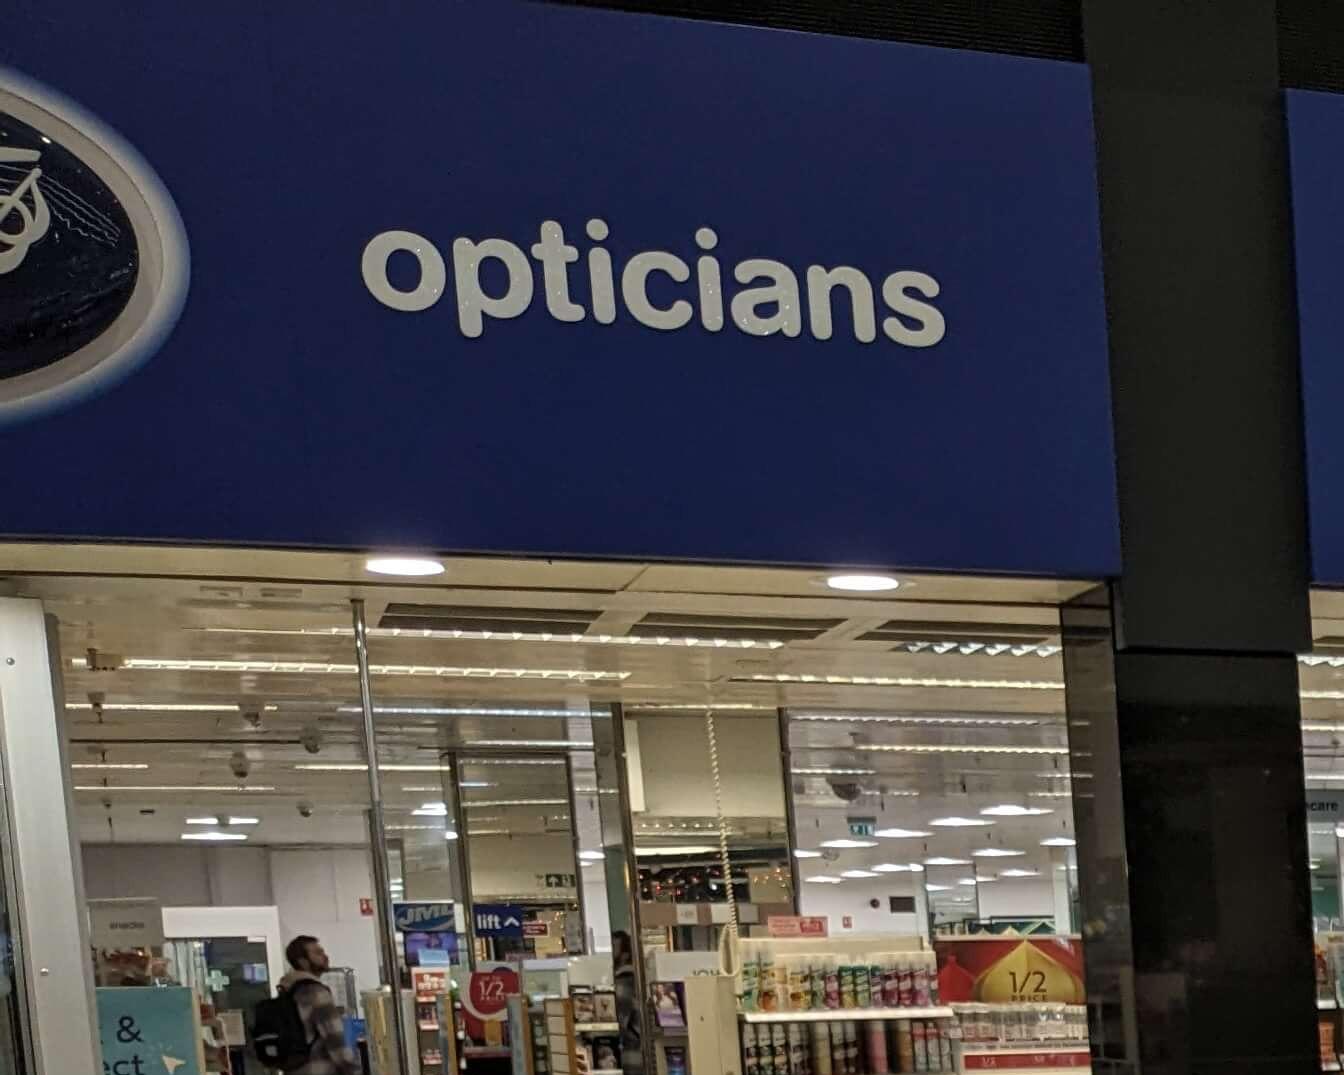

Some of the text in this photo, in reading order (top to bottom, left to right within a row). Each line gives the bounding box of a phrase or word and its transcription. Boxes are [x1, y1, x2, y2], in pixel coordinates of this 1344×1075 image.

[360, 218, 946, 348] opticians
[476, 913, 502, 930] lift
[1008, 970, 1047, 994] 1/2
[116, 1016, 144, 1043] &
